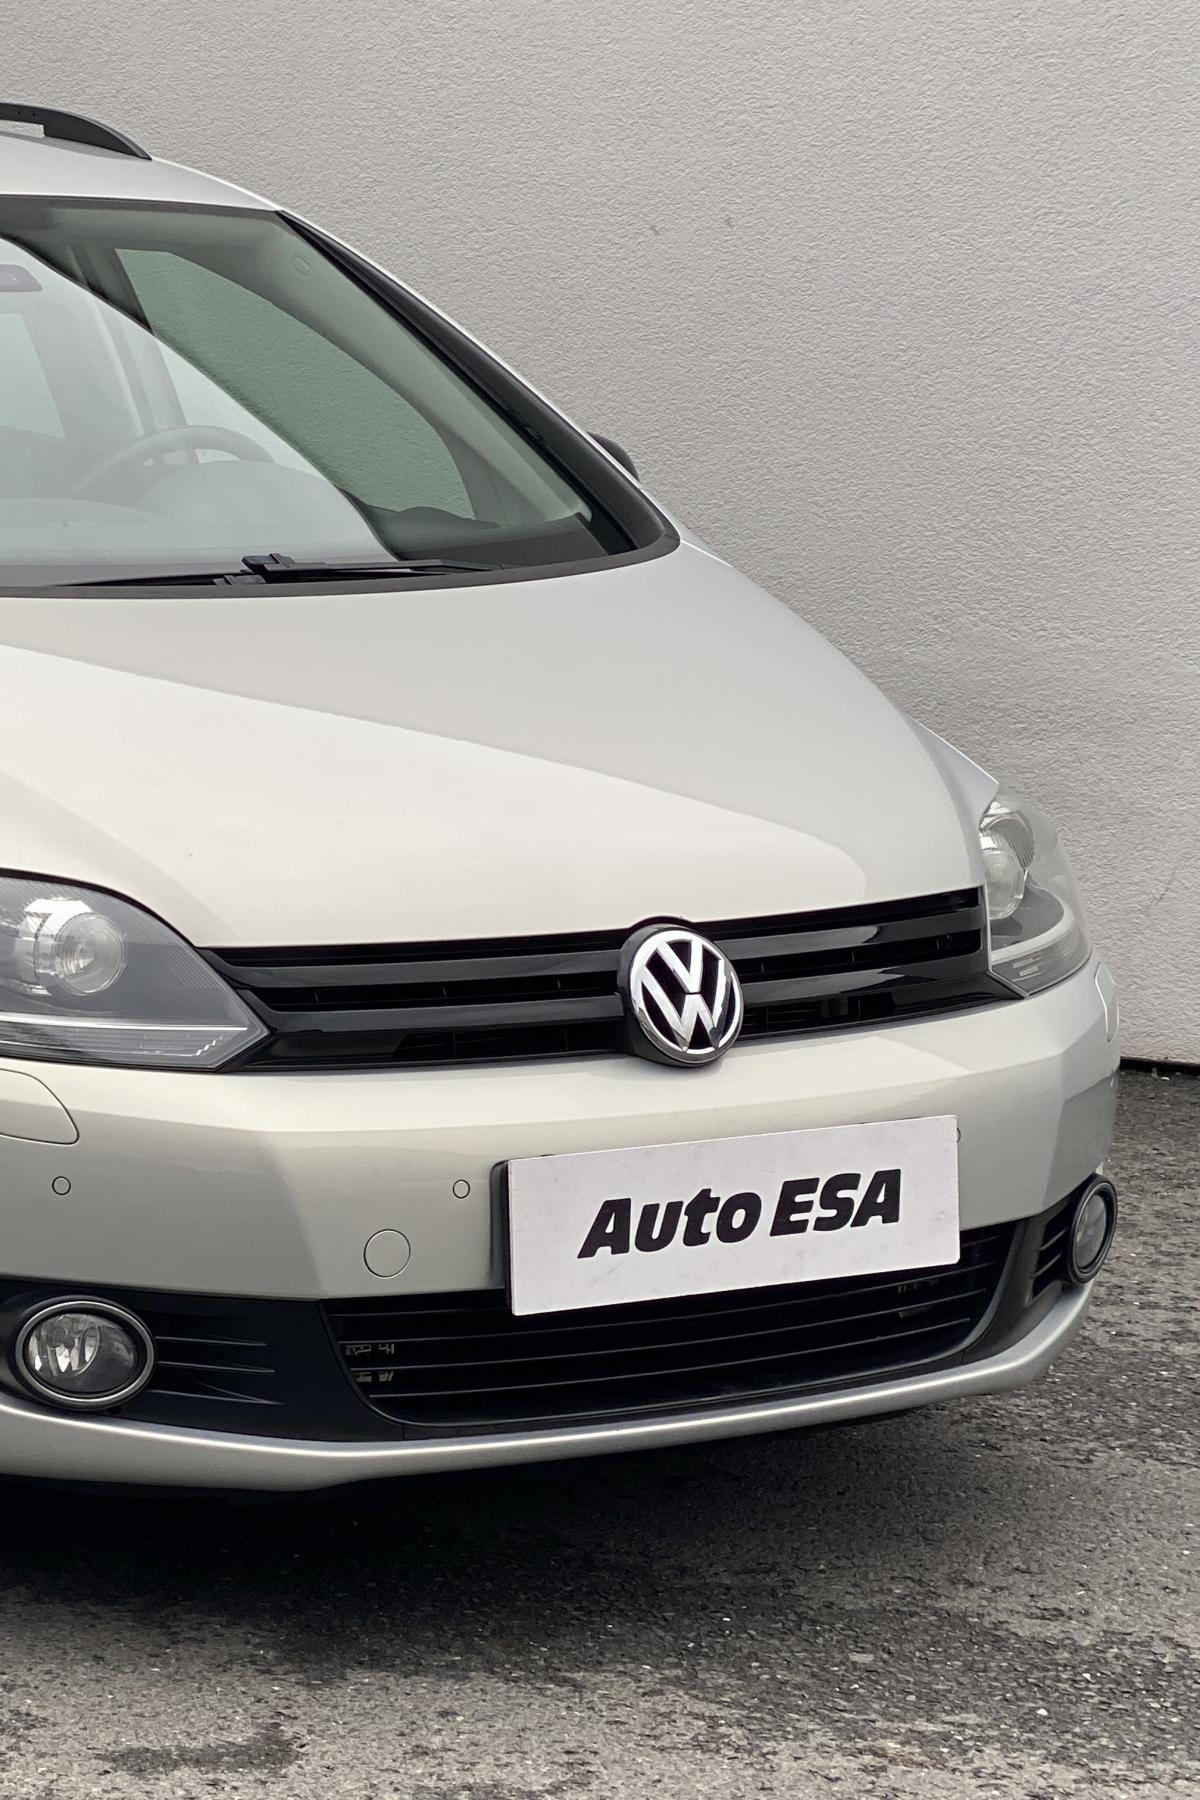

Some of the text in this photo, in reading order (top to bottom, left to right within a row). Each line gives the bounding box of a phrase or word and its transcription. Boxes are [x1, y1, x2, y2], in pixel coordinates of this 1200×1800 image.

[636, 933, 738, 1056] VW
[577, 1168, 902, 1259] Auto ESA
